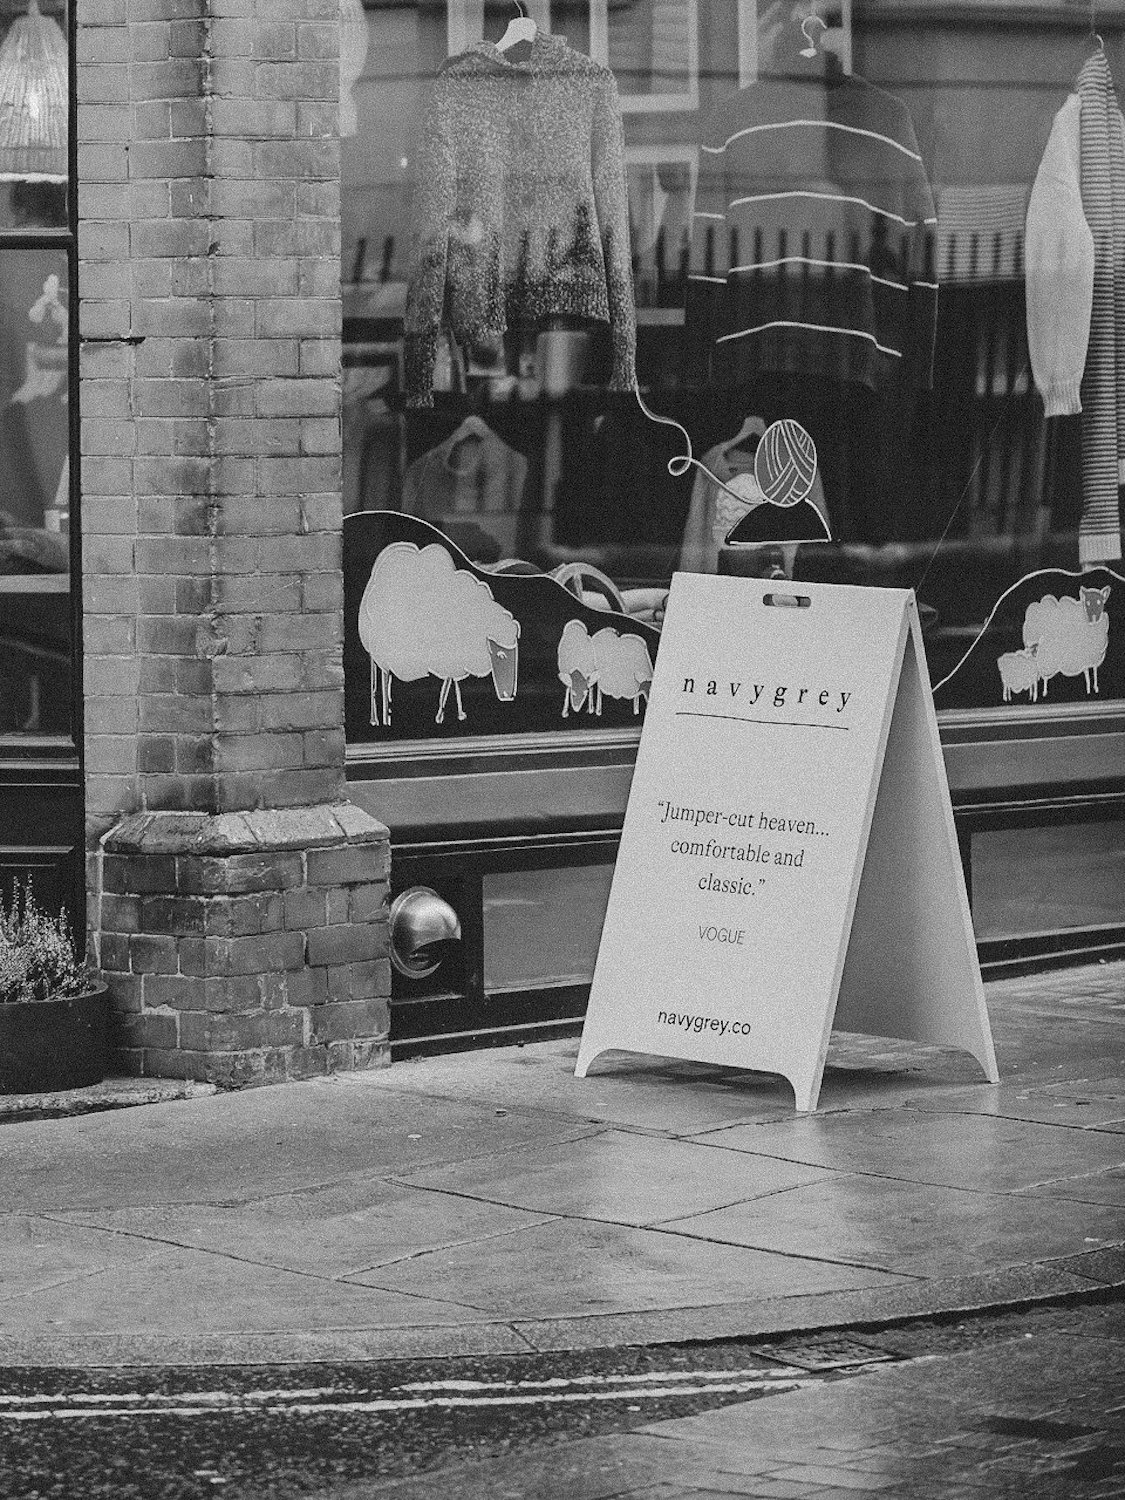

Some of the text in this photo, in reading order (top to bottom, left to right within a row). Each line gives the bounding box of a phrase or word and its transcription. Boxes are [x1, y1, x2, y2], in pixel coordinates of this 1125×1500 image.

[683, 677, 851, 713] navygrey
[657, 799, 830, 837] “Jumper-cut heaven...
[670, 838, 806, 868] comfortable and
[697, 872, 766, 896] classic.”
[698, 925, 747, 945] VOGUE
[657, 1010, 752, 1036] navygrey.co
